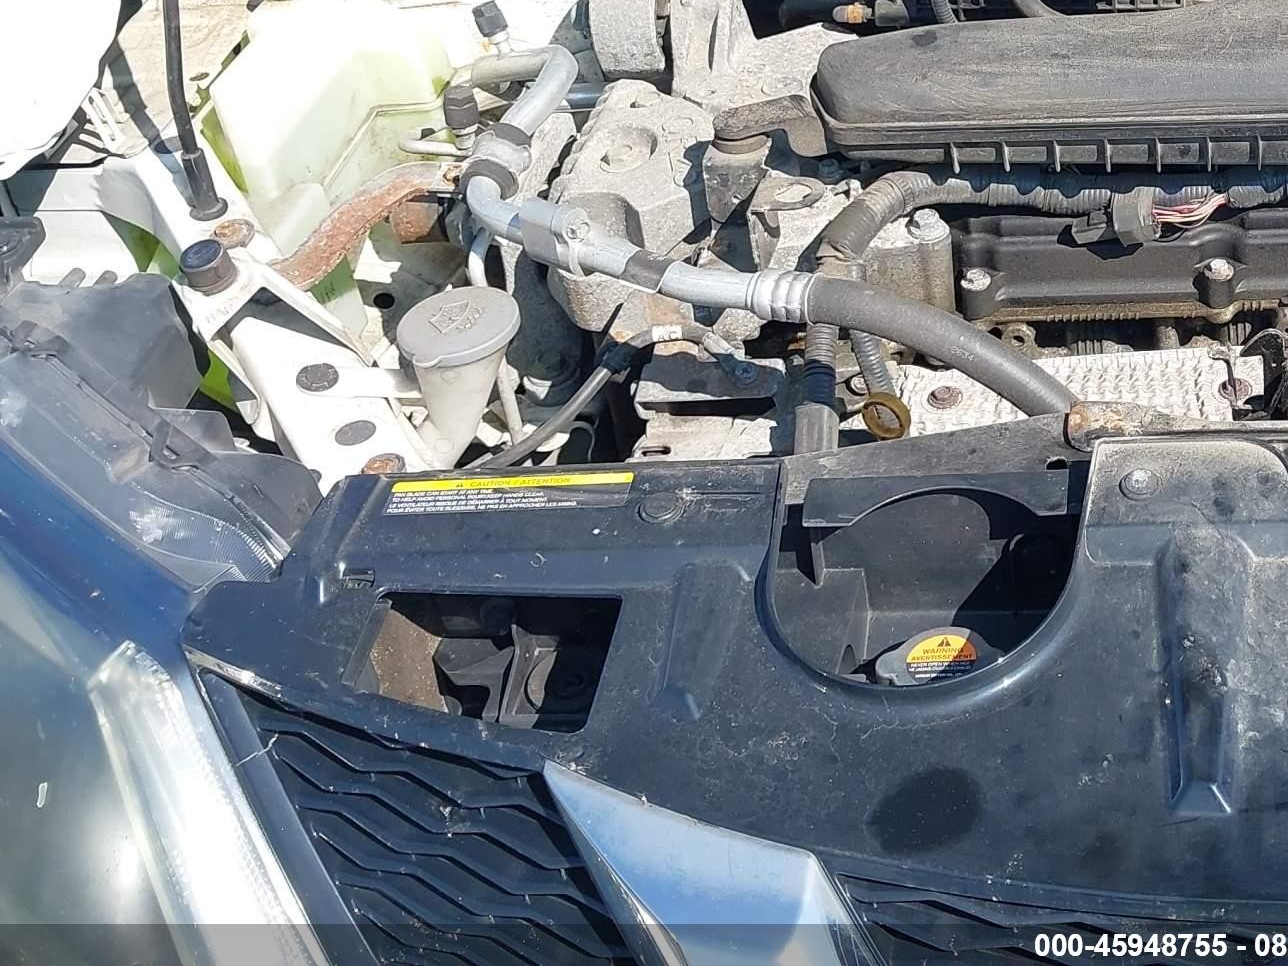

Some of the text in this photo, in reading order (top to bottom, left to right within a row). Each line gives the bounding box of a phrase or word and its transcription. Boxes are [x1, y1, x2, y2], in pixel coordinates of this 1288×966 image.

[470, 480, 511, 488] CAUTION
[519, 477, 571, 485] ATTENTION
[922, 647, 964, 655] WARNING
[911, 653, 973, 661] AVERTISSEMENT
